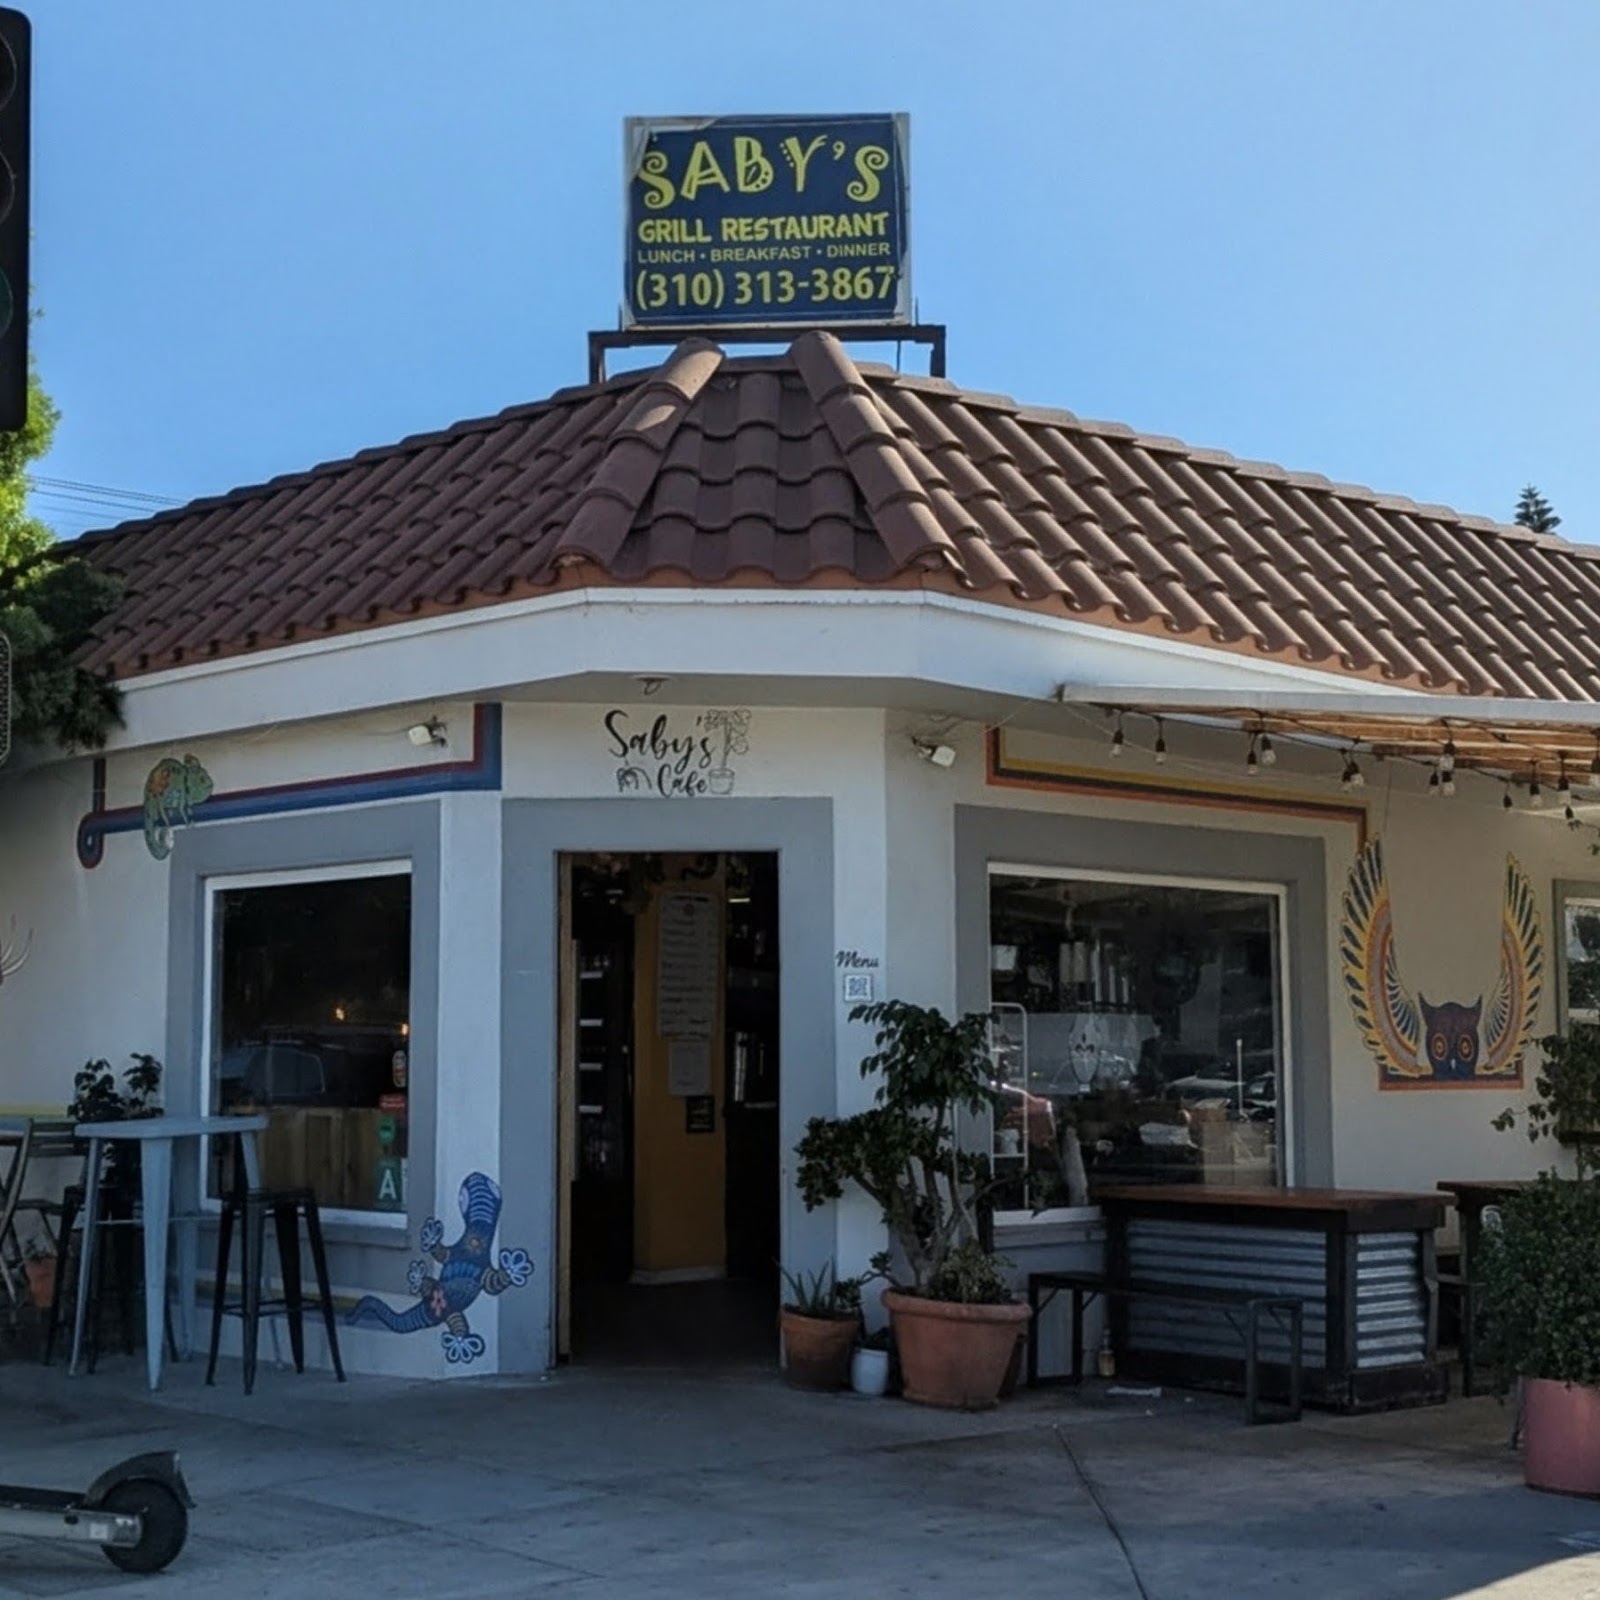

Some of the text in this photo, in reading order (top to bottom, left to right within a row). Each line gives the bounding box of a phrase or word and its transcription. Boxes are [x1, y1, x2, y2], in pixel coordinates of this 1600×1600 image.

[636, 134, 890, 209] SABY'S
[638, 211, 889, 244] GRILL RESTAURANT
[637, 242, 891, 264] LUNCH BREAKFAST DINNER
[636, 265, 895, 311] (310) 313-3867
[604, 709, 716, 774] Saby's
[836, 950, 879, 968] Menu
[378, 1168, 397, 1199] A
